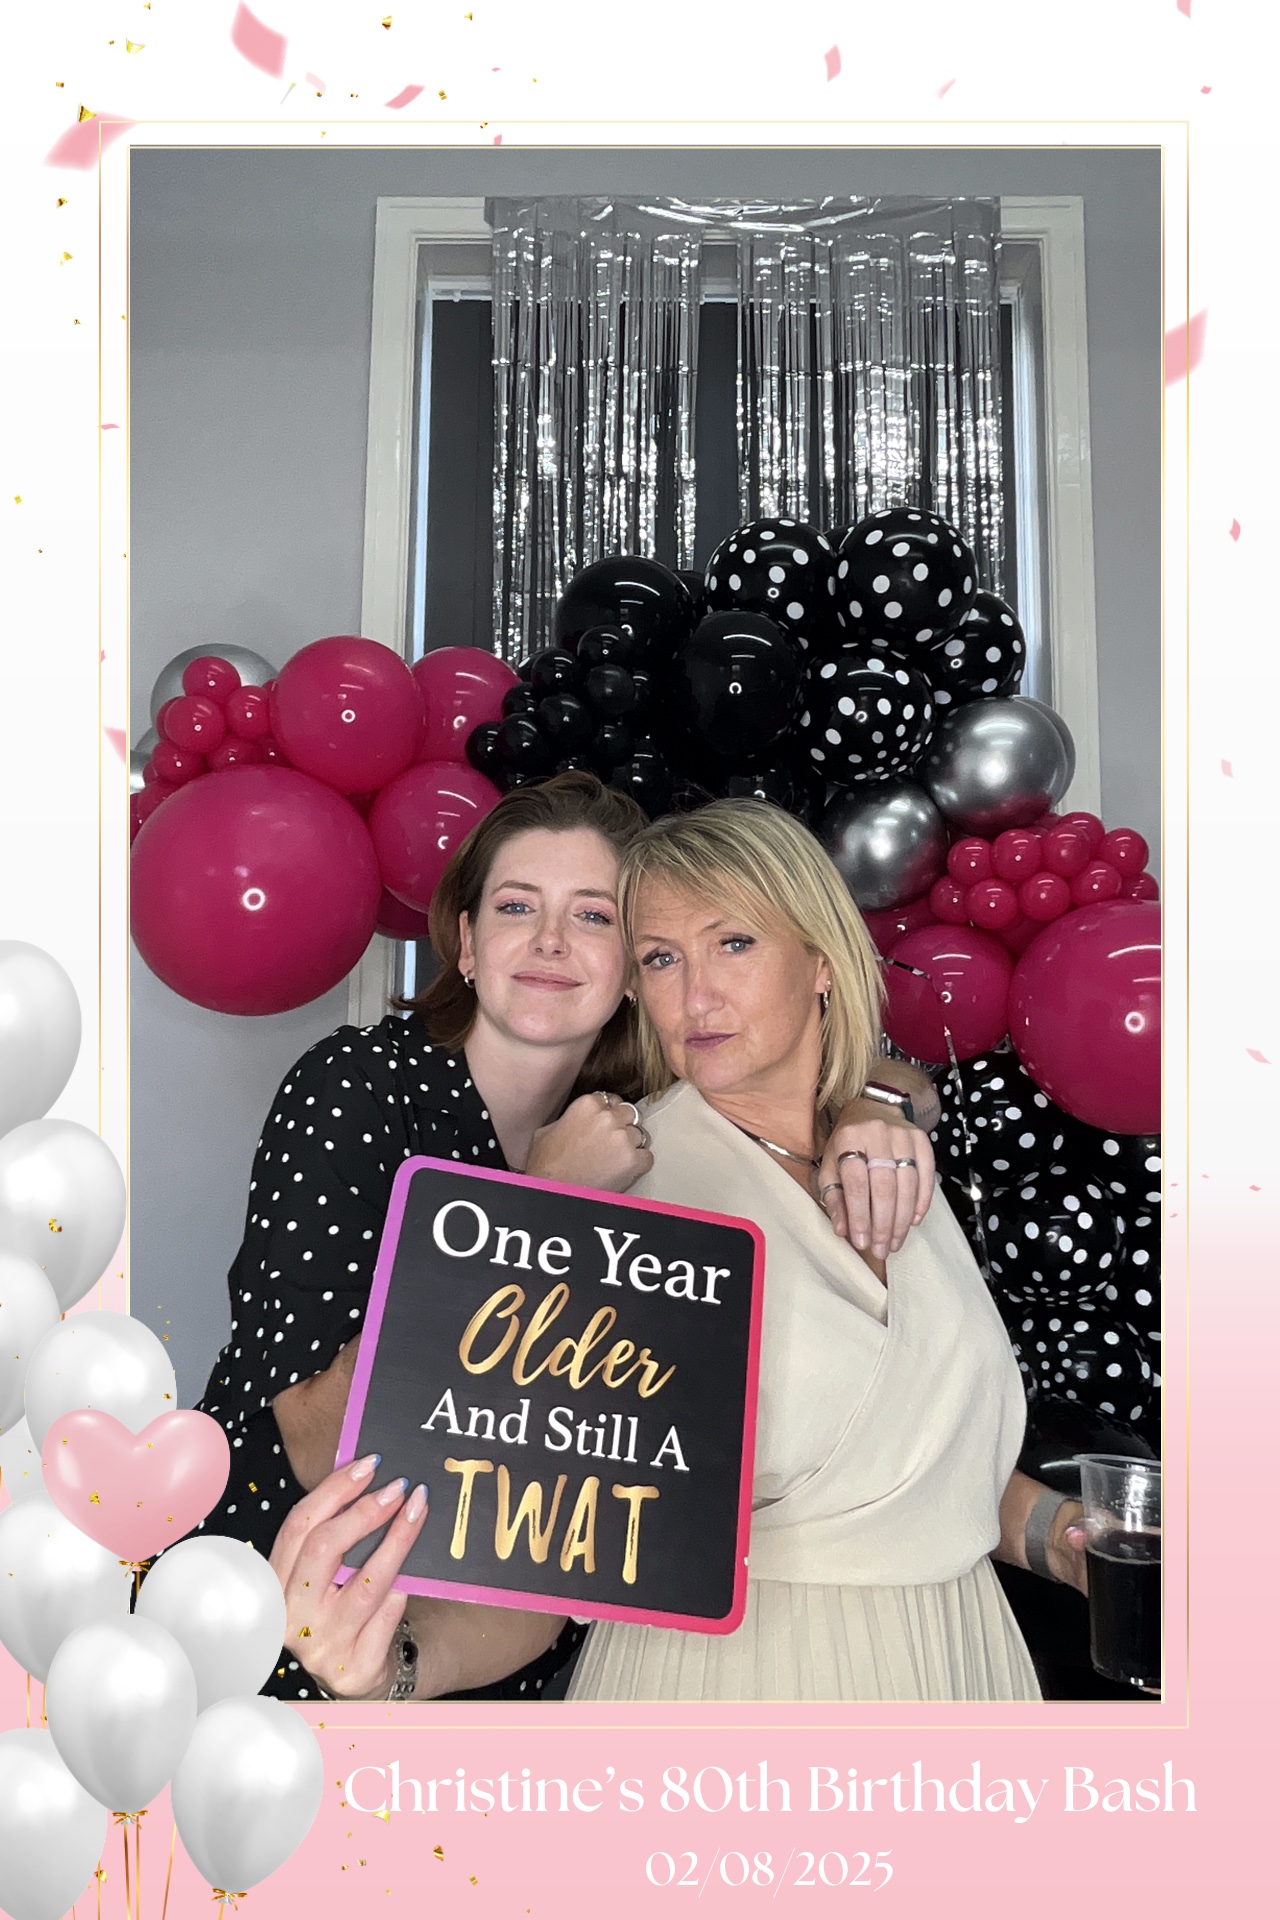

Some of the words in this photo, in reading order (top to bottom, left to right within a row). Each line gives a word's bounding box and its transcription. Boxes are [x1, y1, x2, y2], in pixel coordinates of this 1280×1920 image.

[432, 1199, 573, 1276] One
[594, 1226, 731, 1304] Year
[459, 1282, 676, 1399] Older
[421, 1387, 531, 1445] And
[544, 1406, 638, 1463] Still
[650, 1425, 690, 1471] A
[444, 1457, 660, 1585] TWAT
